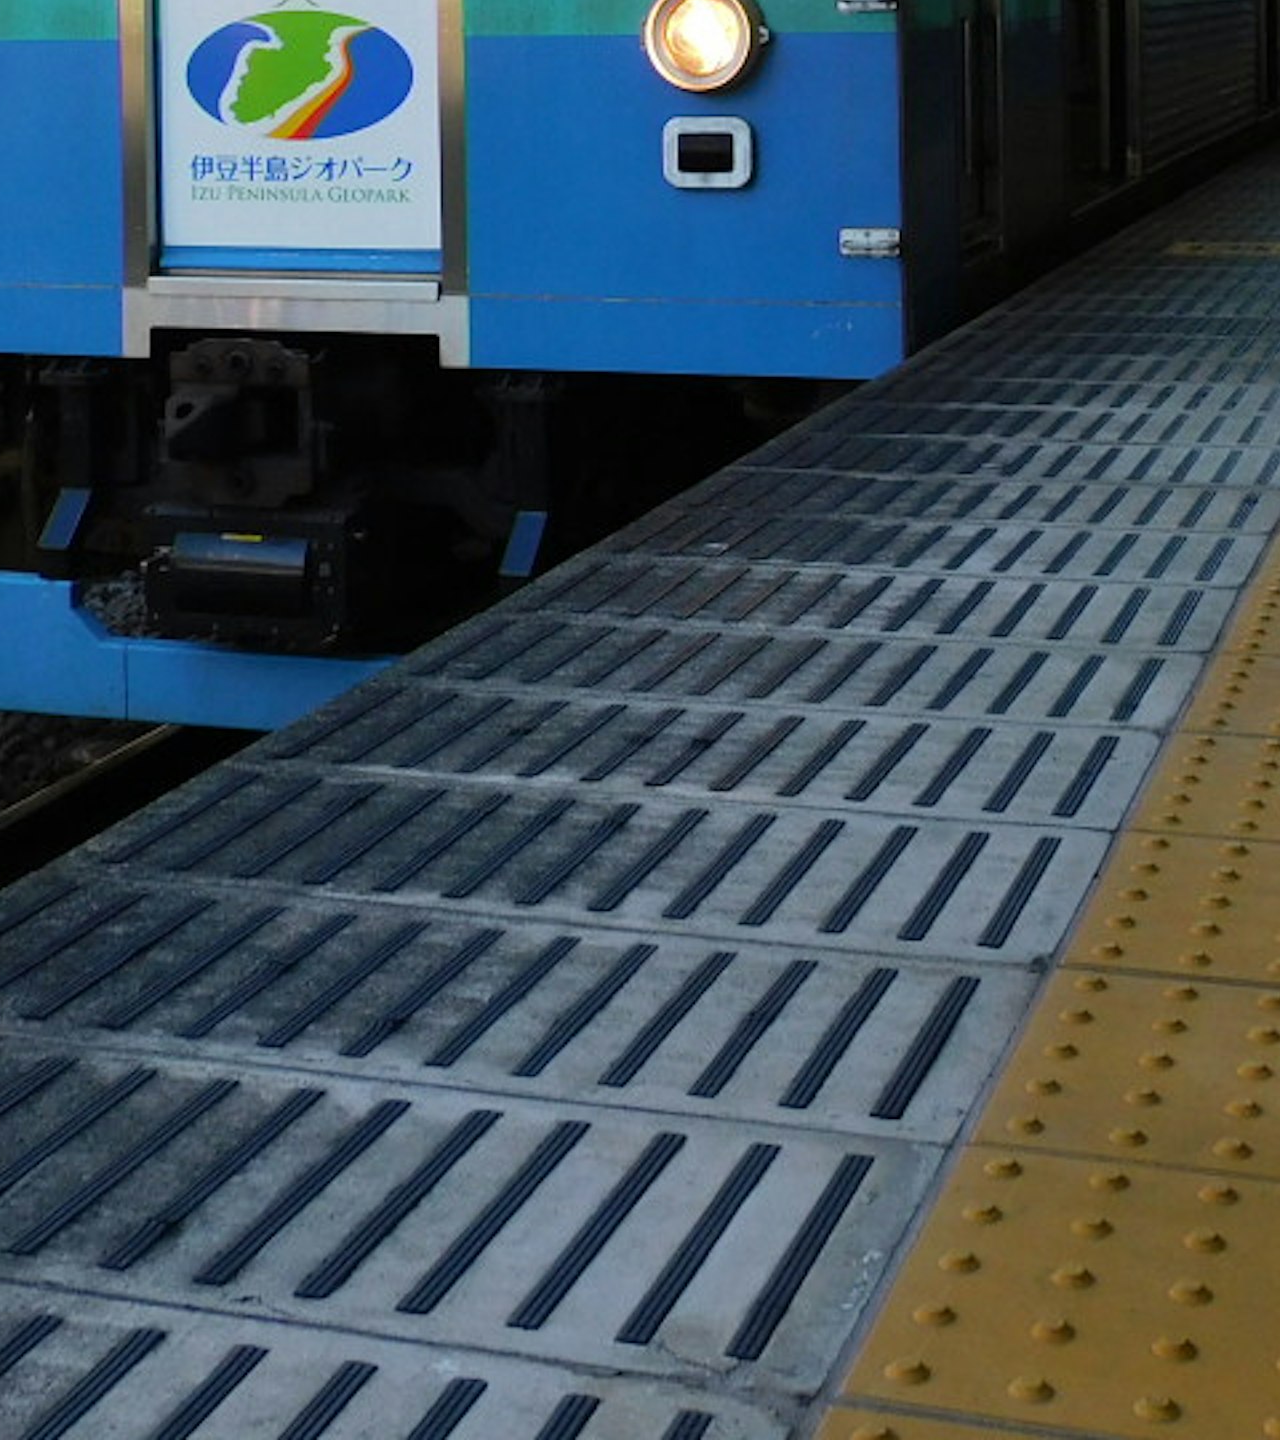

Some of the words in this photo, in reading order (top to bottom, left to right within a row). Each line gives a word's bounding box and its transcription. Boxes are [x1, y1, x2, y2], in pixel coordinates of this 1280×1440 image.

[191, 154, 413, 182] 伊豆半島ジオパーク
[191, 186, 219, 201] IZU
[228, 185, 321, 202] PENINSULA
